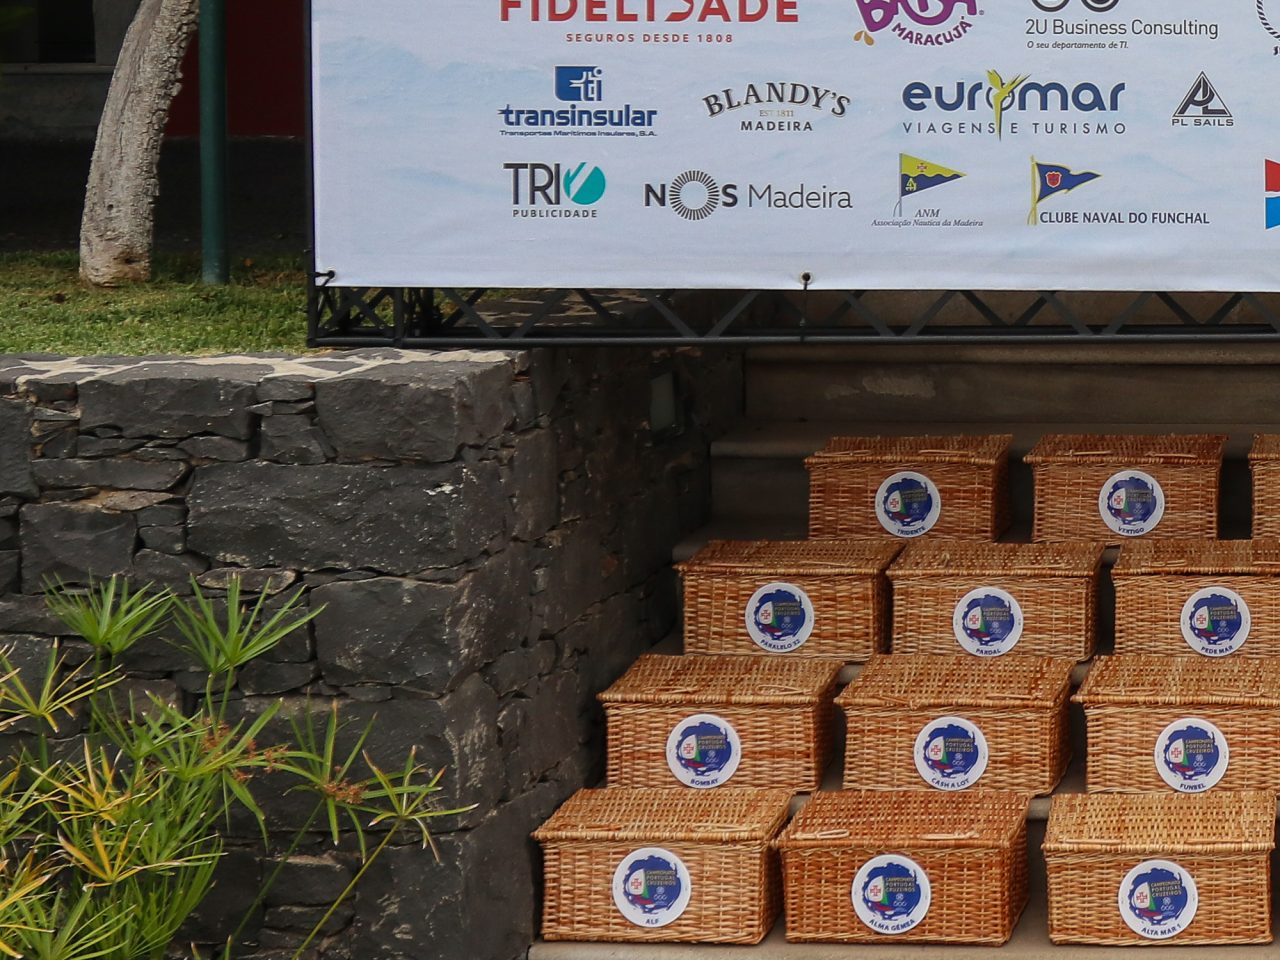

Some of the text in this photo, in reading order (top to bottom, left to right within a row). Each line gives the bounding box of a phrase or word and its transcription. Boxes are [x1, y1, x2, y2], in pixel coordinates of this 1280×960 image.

[891, 16, 973, 46] MARACUJÁ
[1025, 19, 1219, 39] 2U Business Consulting
[566, 33, 733, 43] SEGUROS DESDE 1808
[497, 104, 657, 127] transinsular
[741, 121, 812, 131] MADEIRA
[902, 122, 1126, 135] VIAGENS E TURISMO
[748, 184, 853, 208] Madeira
[513, 209, 597, 218] PUBLICIDADE
[915, 209, 940, 218] ANM
[1039, 211, 1210, 224] CLUBE NAVAL DO FUNCHAL
[1118, 526, 1145, 535] VERTIGO
[931, 778, 950, 788] CASH
[869, 919, 889, 931] ALMA
[1141, 926, 1160, 936] ALTA
[1160, 926, 1176, 936] MAR
